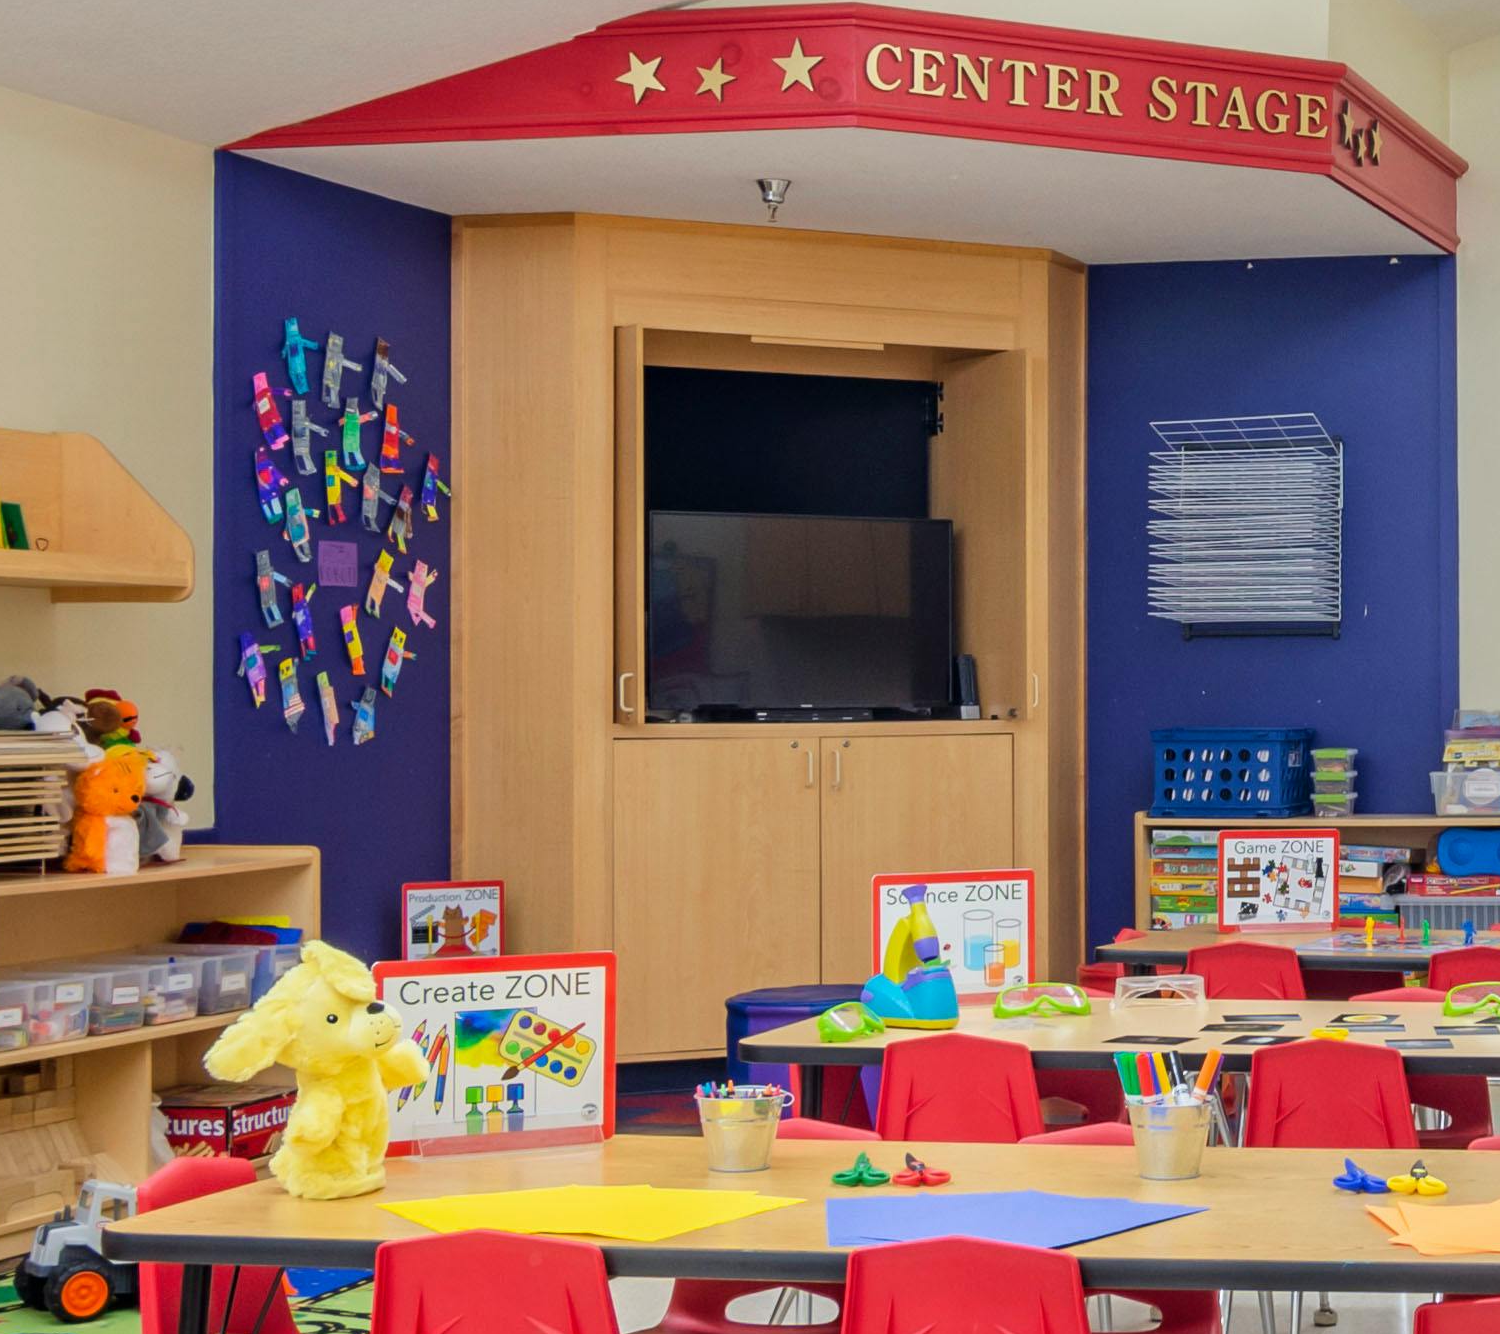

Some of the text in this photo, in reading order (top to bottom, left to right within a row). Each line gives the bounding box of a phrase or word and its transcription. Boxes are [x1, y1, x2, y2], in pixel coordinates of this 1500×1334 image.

[866, 43, 1328, 138] CENTER STAGE
[1235, 840, 1324, 854] Game ZONE
[409, 889, 498, 903] Production ZONE
[886, 883, 1022, 905] Scnce ZONE
[400, 972, 590, 1005] Create ZONE
